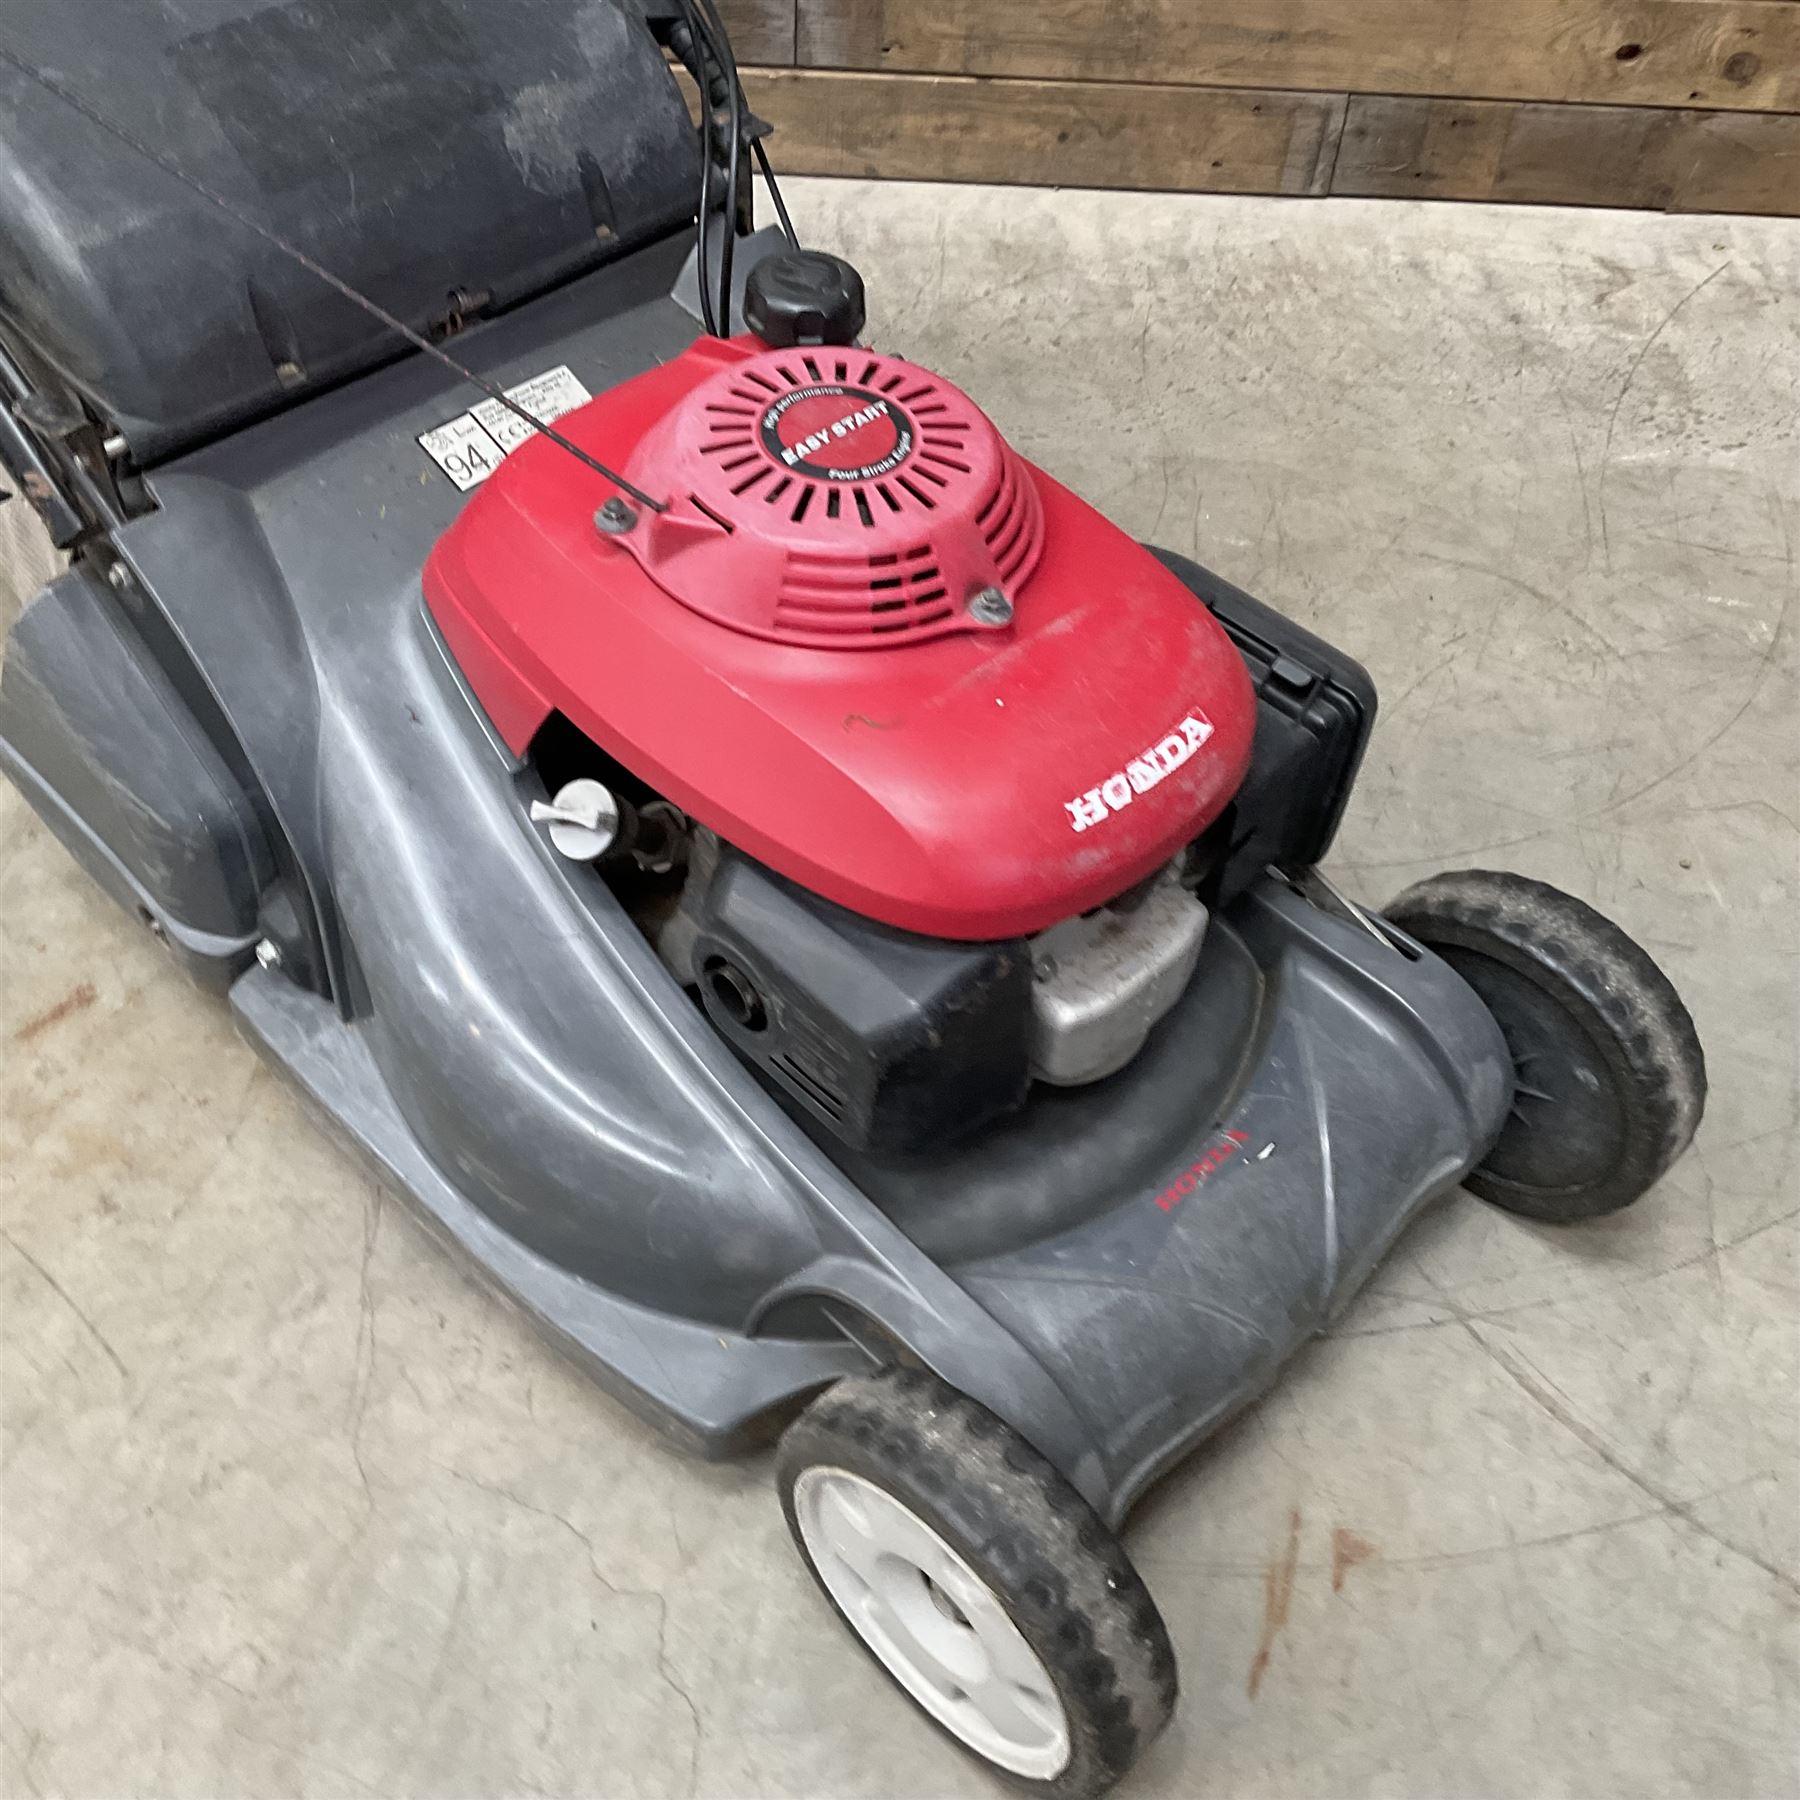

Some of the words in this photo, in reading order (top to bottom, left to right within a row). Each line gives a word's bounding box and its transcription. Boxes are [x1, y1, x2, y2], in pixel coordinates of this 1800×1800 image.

[776, 387, 844, 413] performance
[781, 428, 831, 466] EASY
[831, 400, 889, 438] START
[443, 443, 491, 481] 94
[828, 467, 860, 480] Four
[860, 456, 897, 479] Stroke
[1063, 714, 1215, 833] HONDA
